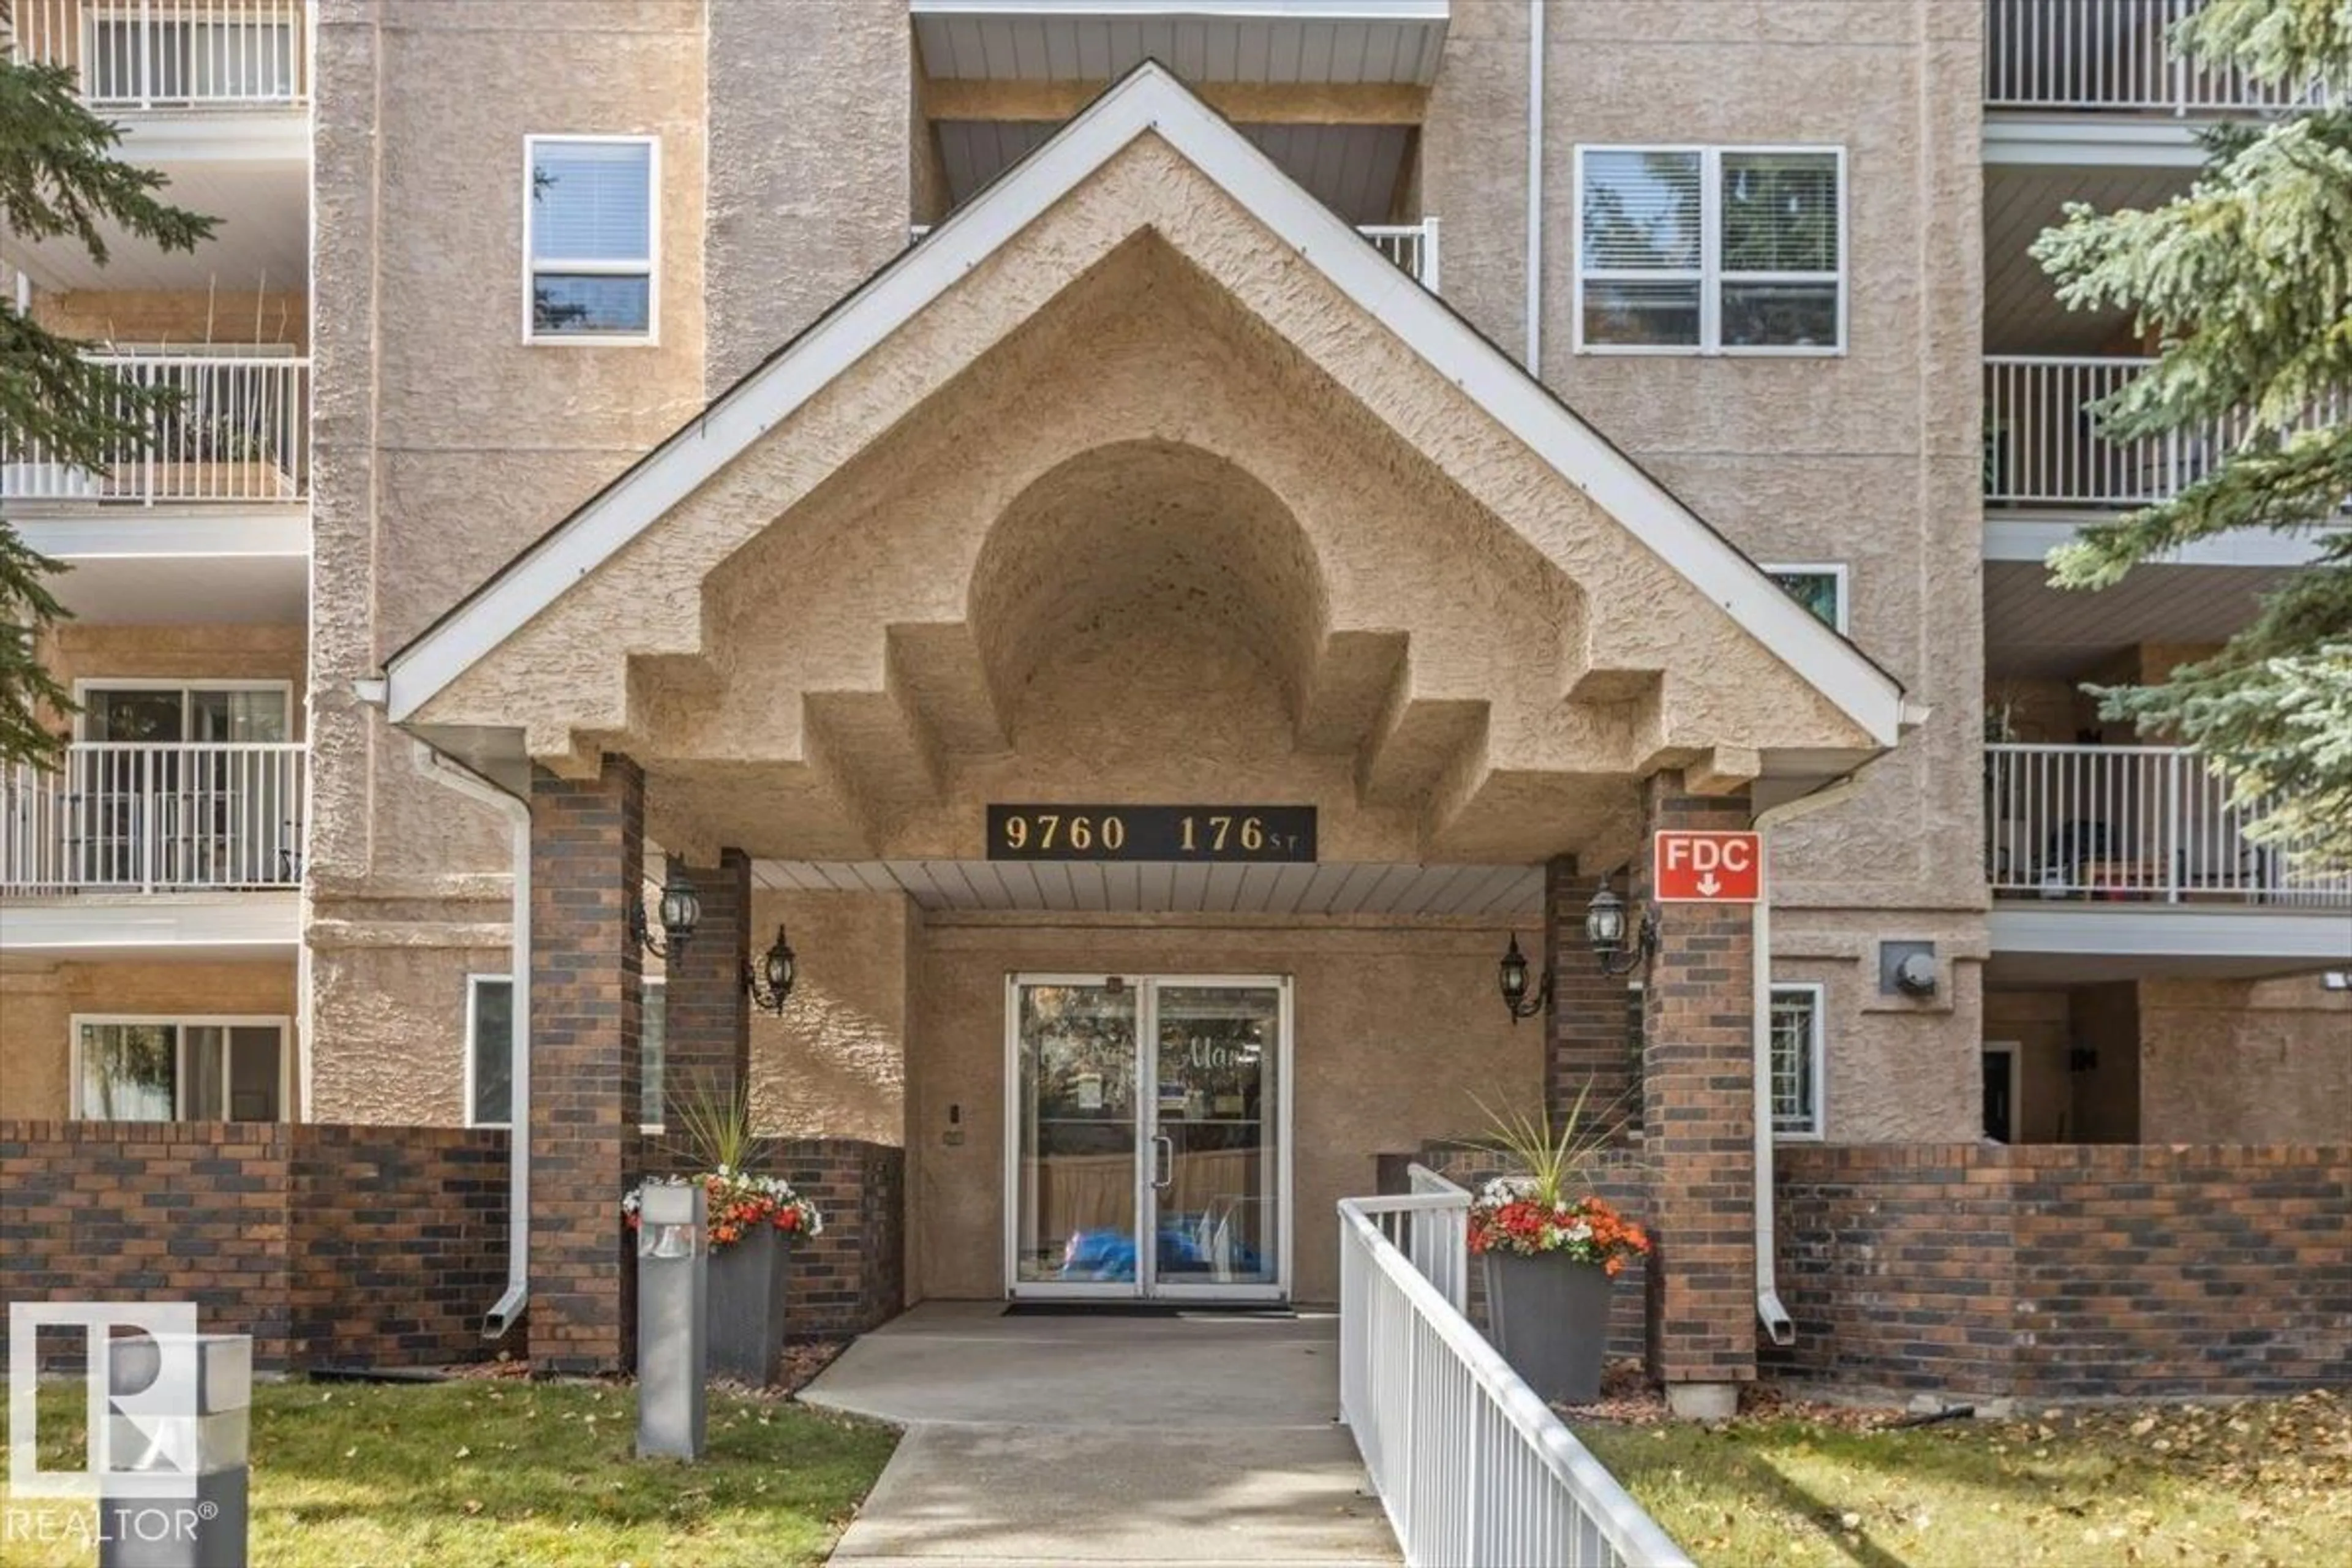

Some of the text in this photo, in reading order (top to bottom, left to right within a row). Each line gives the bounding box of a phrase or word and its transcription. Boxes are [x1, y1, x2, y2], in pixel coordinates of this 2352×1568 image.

[1006, 815, 1125, 850] 9760
[1180, 816, 1264, 851] 176
[1667, 838, 1750, 872] FDC
